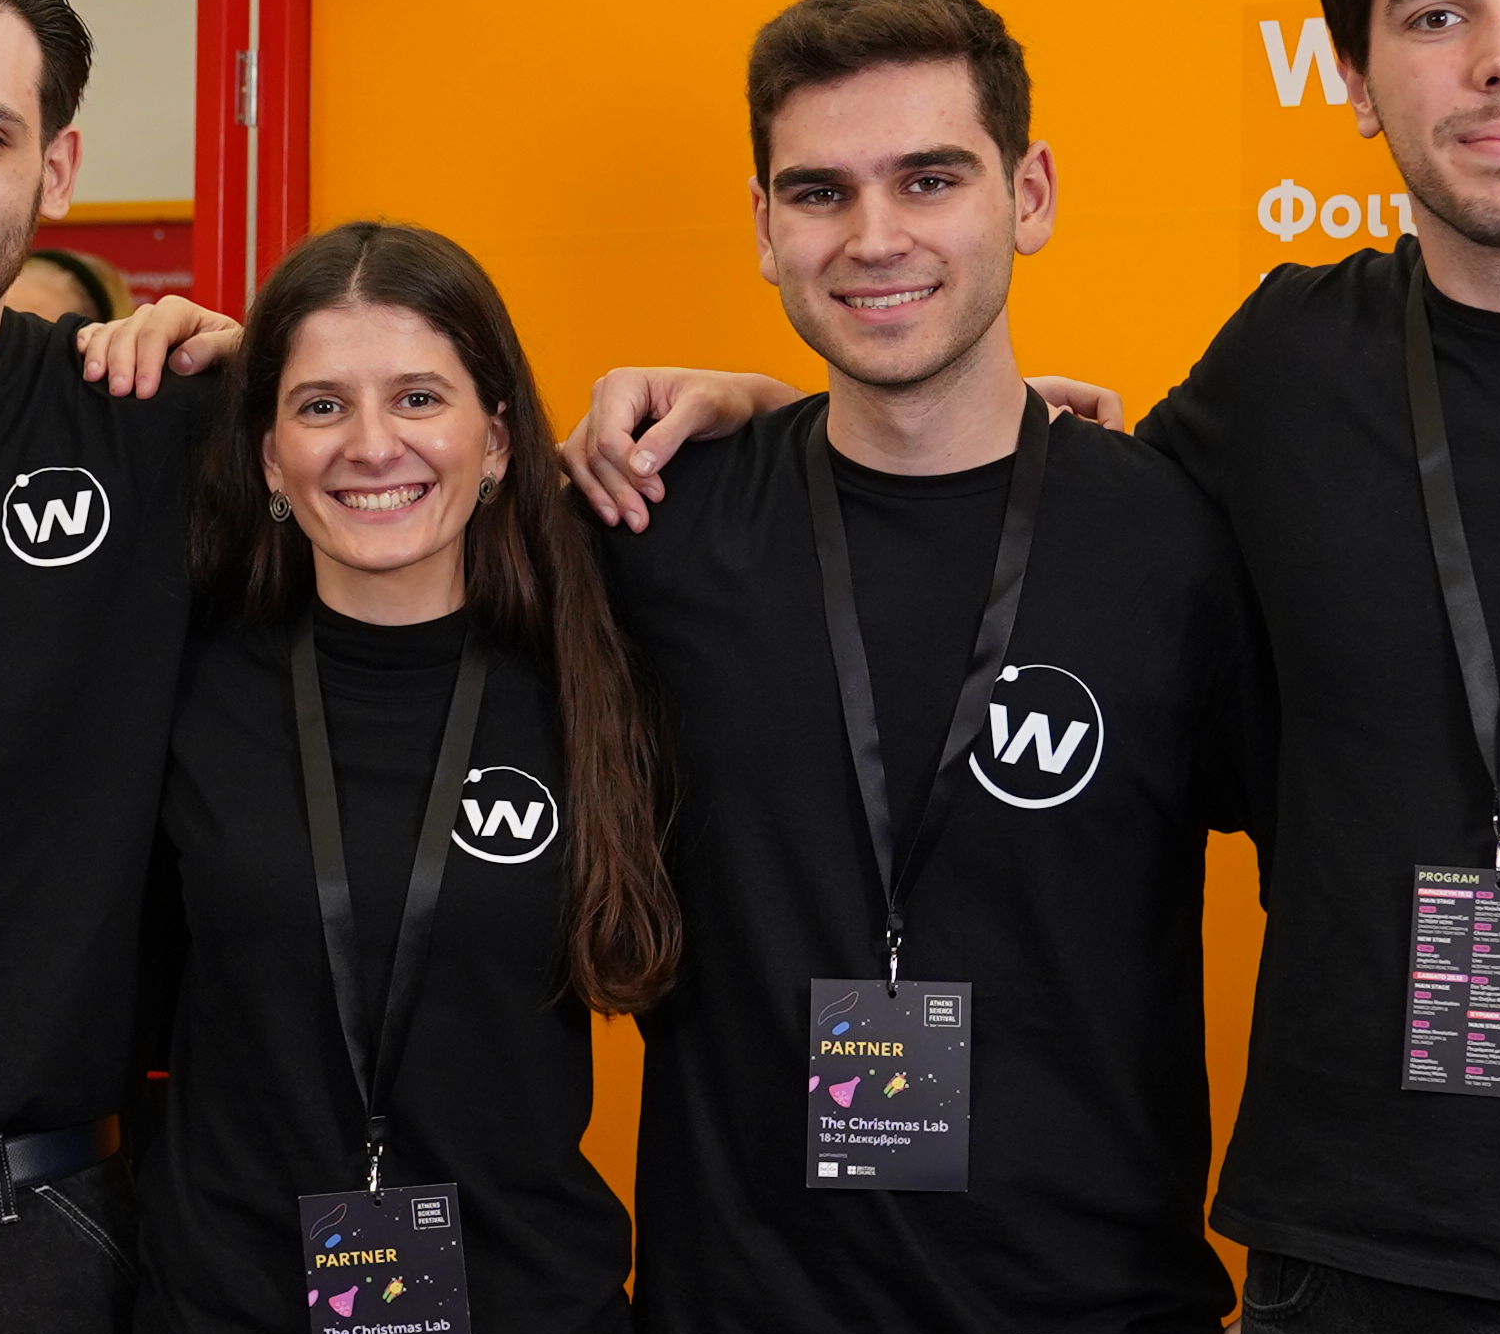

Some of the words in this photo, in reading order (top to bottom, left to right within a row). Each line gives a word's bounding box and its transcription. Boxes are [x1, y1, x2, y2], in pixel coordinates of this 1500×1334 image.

[1418, 871, 1480, 885] PROGRAM
[929, 1015, 956, 1023] FESTIVAL
[820, 1040, 904, 1057] PARTNER
[820, 1117, 846, 1130] The
[849, 1118, 920, 1132] Christmas
[923, 1120, 949, 1132] Lab
[819, 1133, 846, 1143] 18-21
[848, 1133, 911, 1146] Δεκεμβρίου
[418, 1217, 445, 1225] FESTIVAL
[315, 1248, 398, 1269] PARTNER
[425, 1319, 451, 1332] Lab
